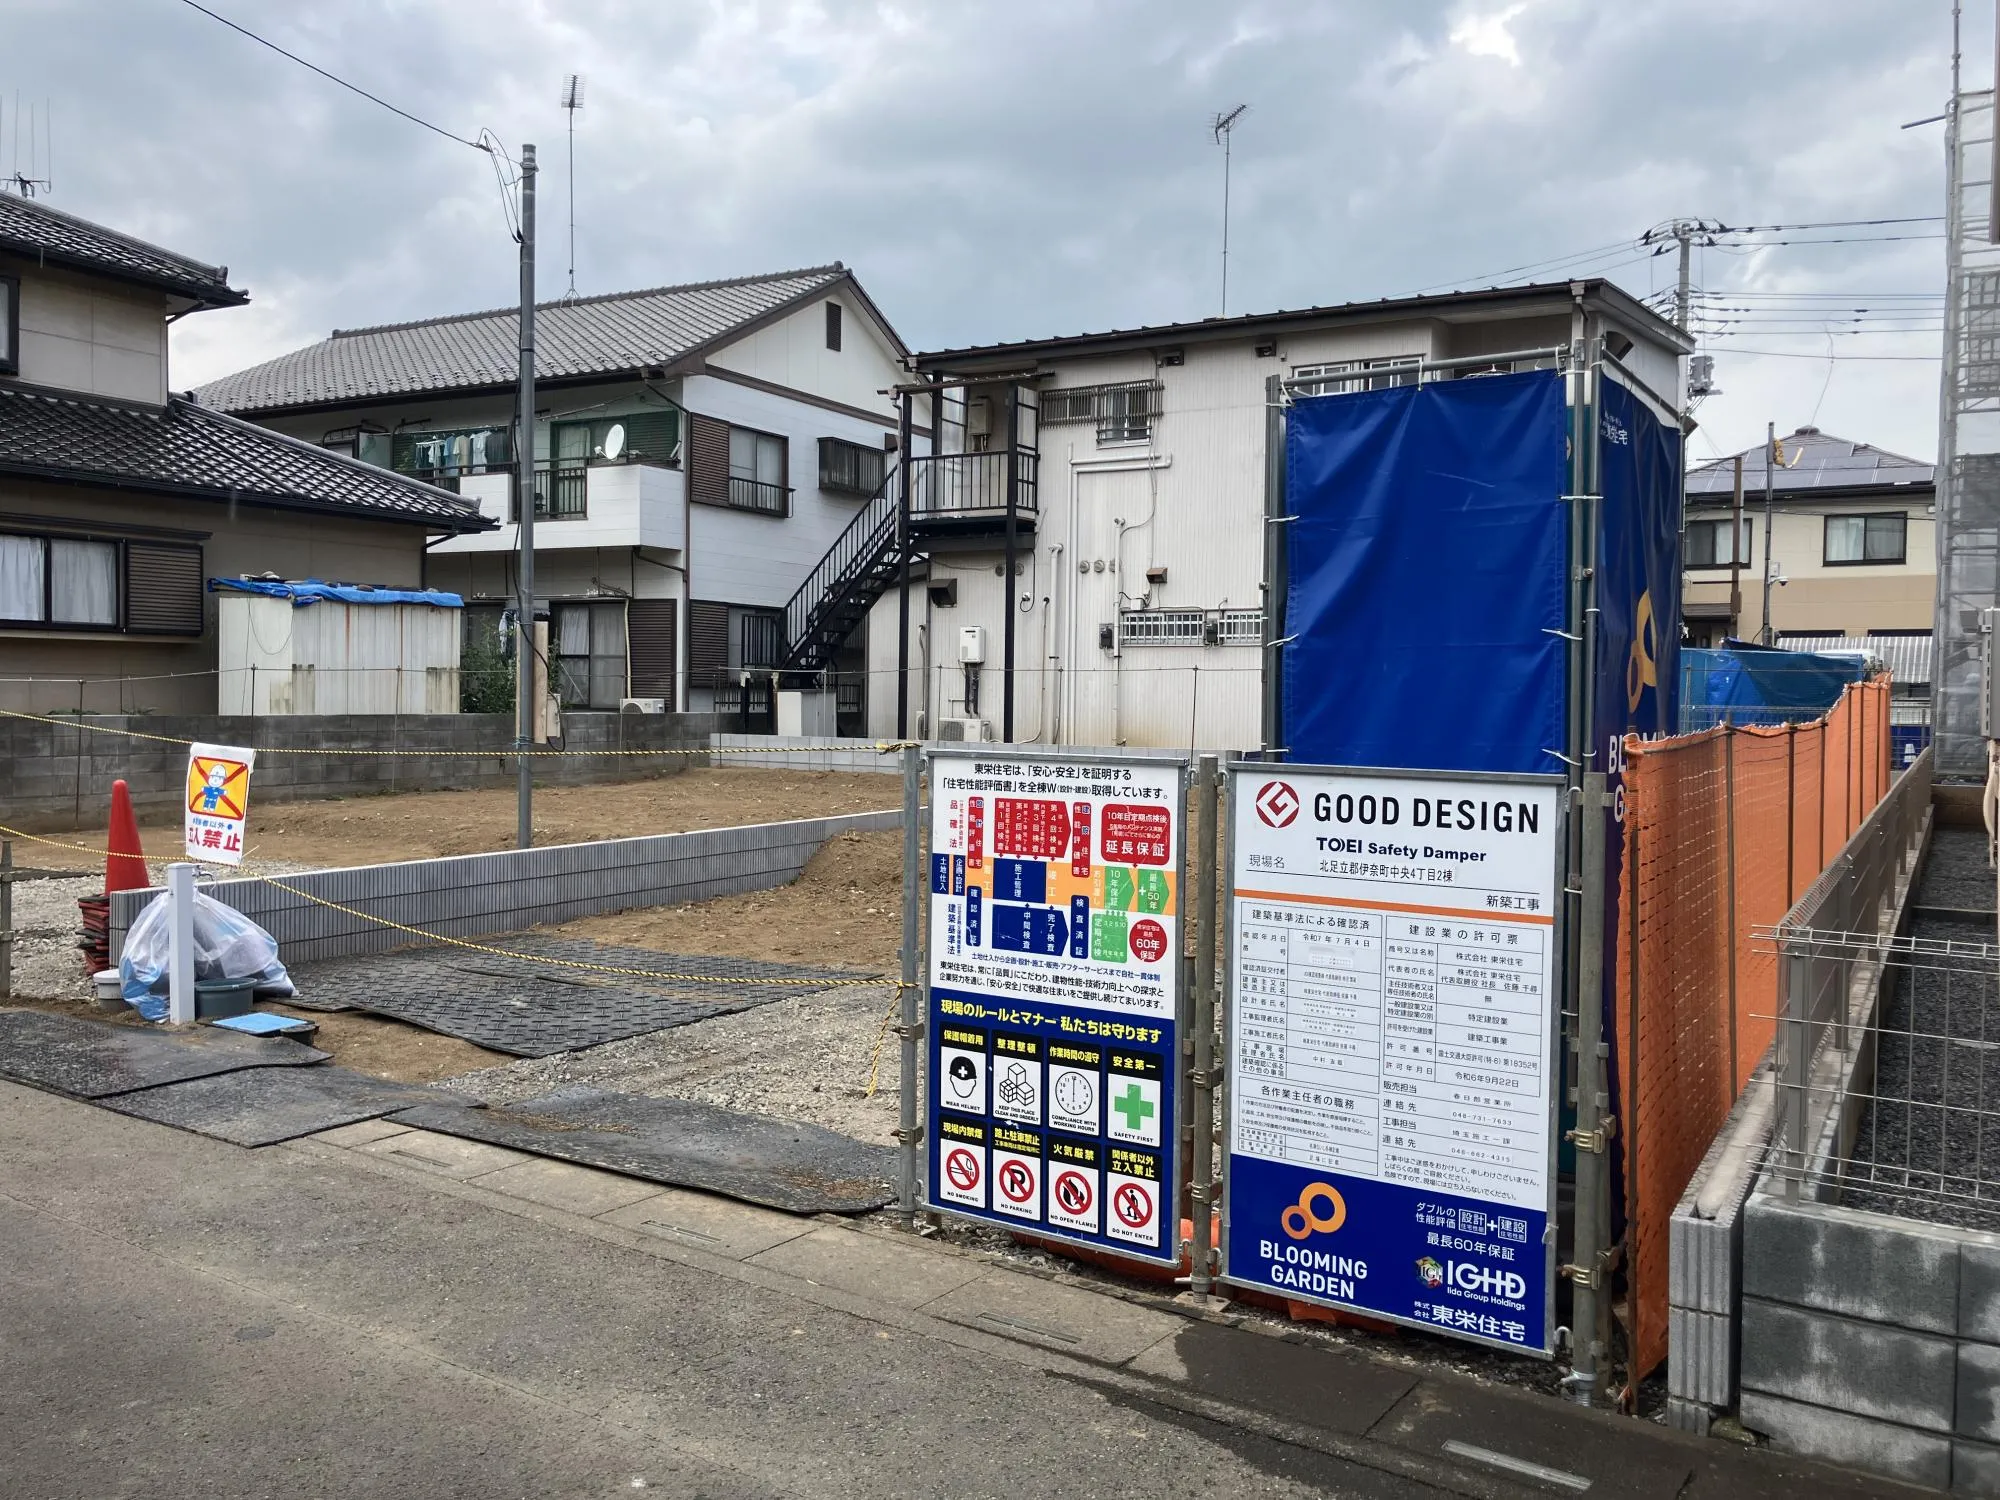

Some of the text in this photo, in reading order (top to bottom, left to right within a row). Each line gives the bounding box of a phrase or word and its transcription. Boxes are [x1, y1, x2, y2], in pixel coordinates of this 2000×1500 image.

[1314, 792, 1538, 833] GOOD DESIGN
[1106, 840, 1164, 857] 延長保証
[1316, 836, 1486, 862] TOEI Safety Damper
[1249, 854, 1284, 869] 現場名
[939, 856, 947, 892] 土地仕入
[1320, 859, 1452, 882] 北足立郡伊奈町中央4丁目2棟
[1486, 894, 1539, 910] 新築工事
[1075, 898, 1084, 956] 検査済証
[1252, 909, 1369, 930] 建築基準法による確認済
[1023, 911, 1031, 950] 中間検査
[1047, 913, 1056, 953] 完了検査
[1409, 924, 1518, 944] 建設業の許可票
[1136, 939, 1159, 951] 60年
[1140, 951, 1155, 961] 保証
[1456, 952, 1486, 963] 株式会社
[941, 999, 1161, 1042] 現場のルールとマナー 私たちは守ります
[1112, 1056, 1155, 1070] 安全第一
[1383, 1080, 1416, 1093] 販売担当
[1456, 1071, 1518, 1087] 令和6年9月22日
[1261, 1085, 1355, 1109] 各作業主任者の職務
[1383, 1098, 1415, 1111] 連絡先
[1052, 1114, 1082, 1123] COMPLIANCE
[1053, 1120, 1094, 1132] WORKING HOURS
[1383, 1116, 1415, 1129] 工事担当
[1114, 1131, 1153, 1143] SAFETY FIRST
[1382, 1134, 1415, 1148] 連絡先
[1112, 1149, 1154, 1166] 関係者以外
[1112, 1160, 1155, 1177] 立入禁止
[956, 1193, 978, 1202] SMOKING
[1009, 1205, 1032, 1214] PARKING
[1416, 1201, 1455, 1218] ダブルの
[1075, 1219, 1096, 1228] FLAMES
[1416, 1213, 1455, 1229] 性能評価
[1461, 1211, 1484, 1226] 設計
[1501, 1218, 1524, 1234] 建設
[1135, 1232, 1153, 1241] ENTER
[1427, 1231, 1514, 1261] 最長60年保証
[1260, 1239, 1367, 1279] BLOOMING
[1271, 1265, 1354, 1300] GARDEN
[1447, 1260, 1525, 1299] IGHD
[1414, 1300, 1429, 1310] 株式
[1447, 1286, 1525, 1311] Iida Group Holdings
[1413, 1309, 1429, 1319] 会社
[1431, 1304, 1524, 1341] 東栄住宅
